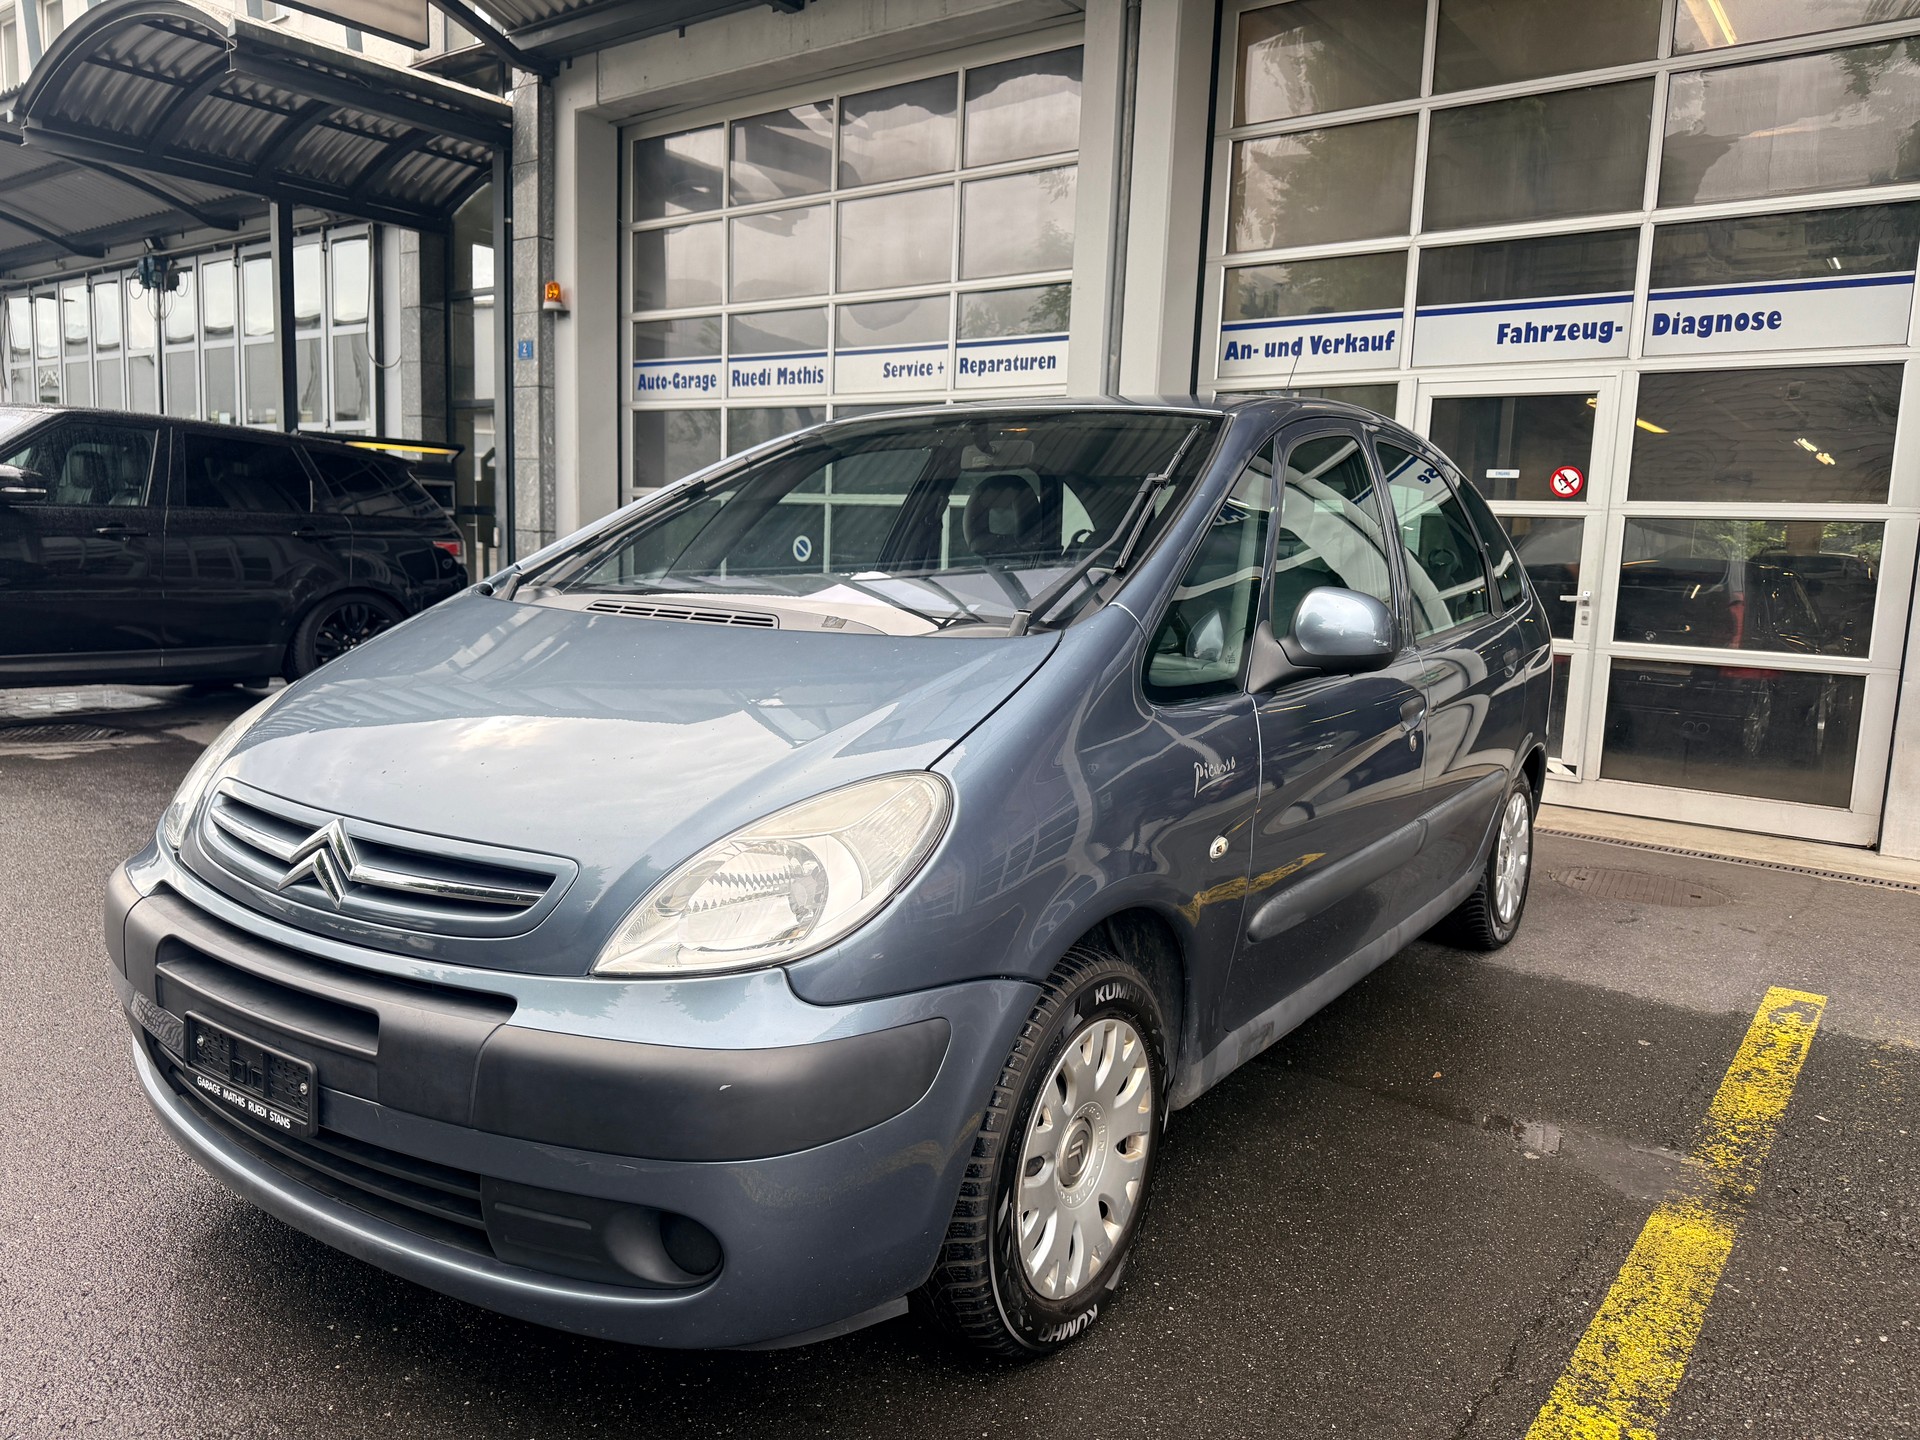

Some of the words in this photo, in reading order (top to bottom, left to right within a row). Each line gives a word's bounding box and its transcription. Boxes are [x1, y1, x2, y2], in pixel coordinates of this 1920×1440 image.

[1496, 320, 1623, 344] Fahrzeug-
[1652, 310, 1782, 337] Diagnose
[1224, 341, 1259, 361] An-
[1264, 336, 1303, 358] und
[1310, 329, 1395, 355] Verkauf
[638, 373, 717, 391] Auto-Garage
[732, 368, 771, 387] Ruedi
[777, 366, 824, 385] Mathis
[883, 360, 933, 378] Service
[937, 361, 944, 374] +
[959, 354, 1056, 376] Reparaturen
[1193, 756, 1235, 798] Picasso
[197, 1076, 220, 1095] GARAGE
[223, 1089, 246, 1108] MATHIS
[248, 1102, 267, 1118] RUEDI
[269, 1111, 291, 1129] STANS
